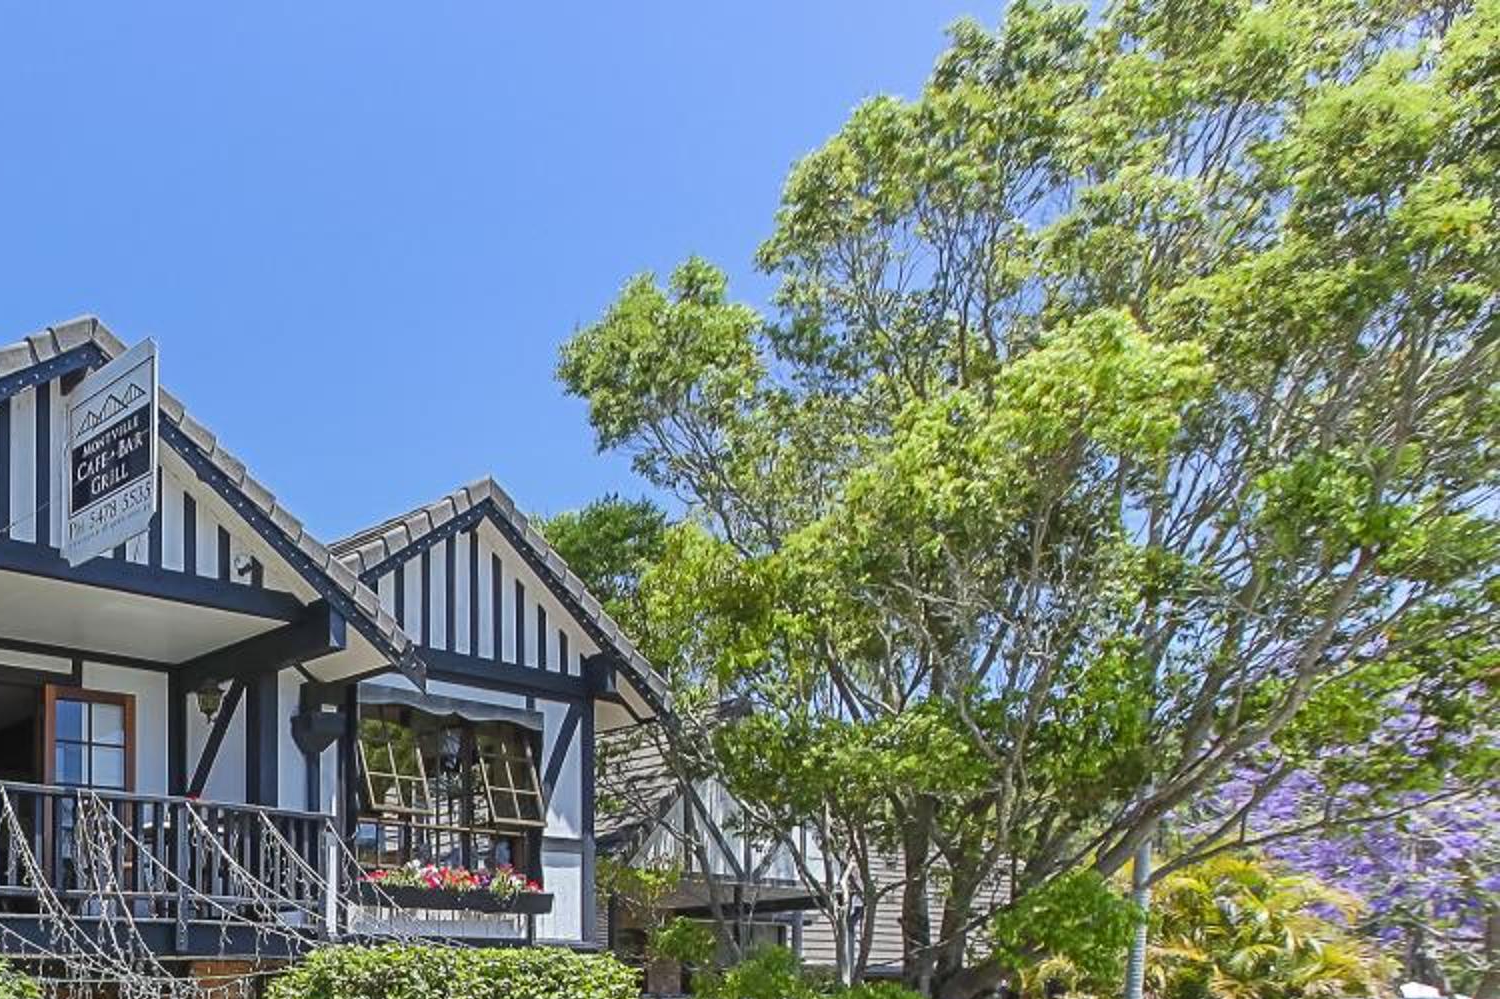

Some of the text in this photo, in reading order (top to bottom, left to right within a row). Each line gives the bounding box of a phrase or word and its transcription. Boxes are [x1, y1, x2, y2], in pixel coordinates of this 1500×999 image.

[82, 415, 139, 458] MONTVILLE
[117, 431, 144, 459] BAR
[91, 463, 129, 494] GRILL
